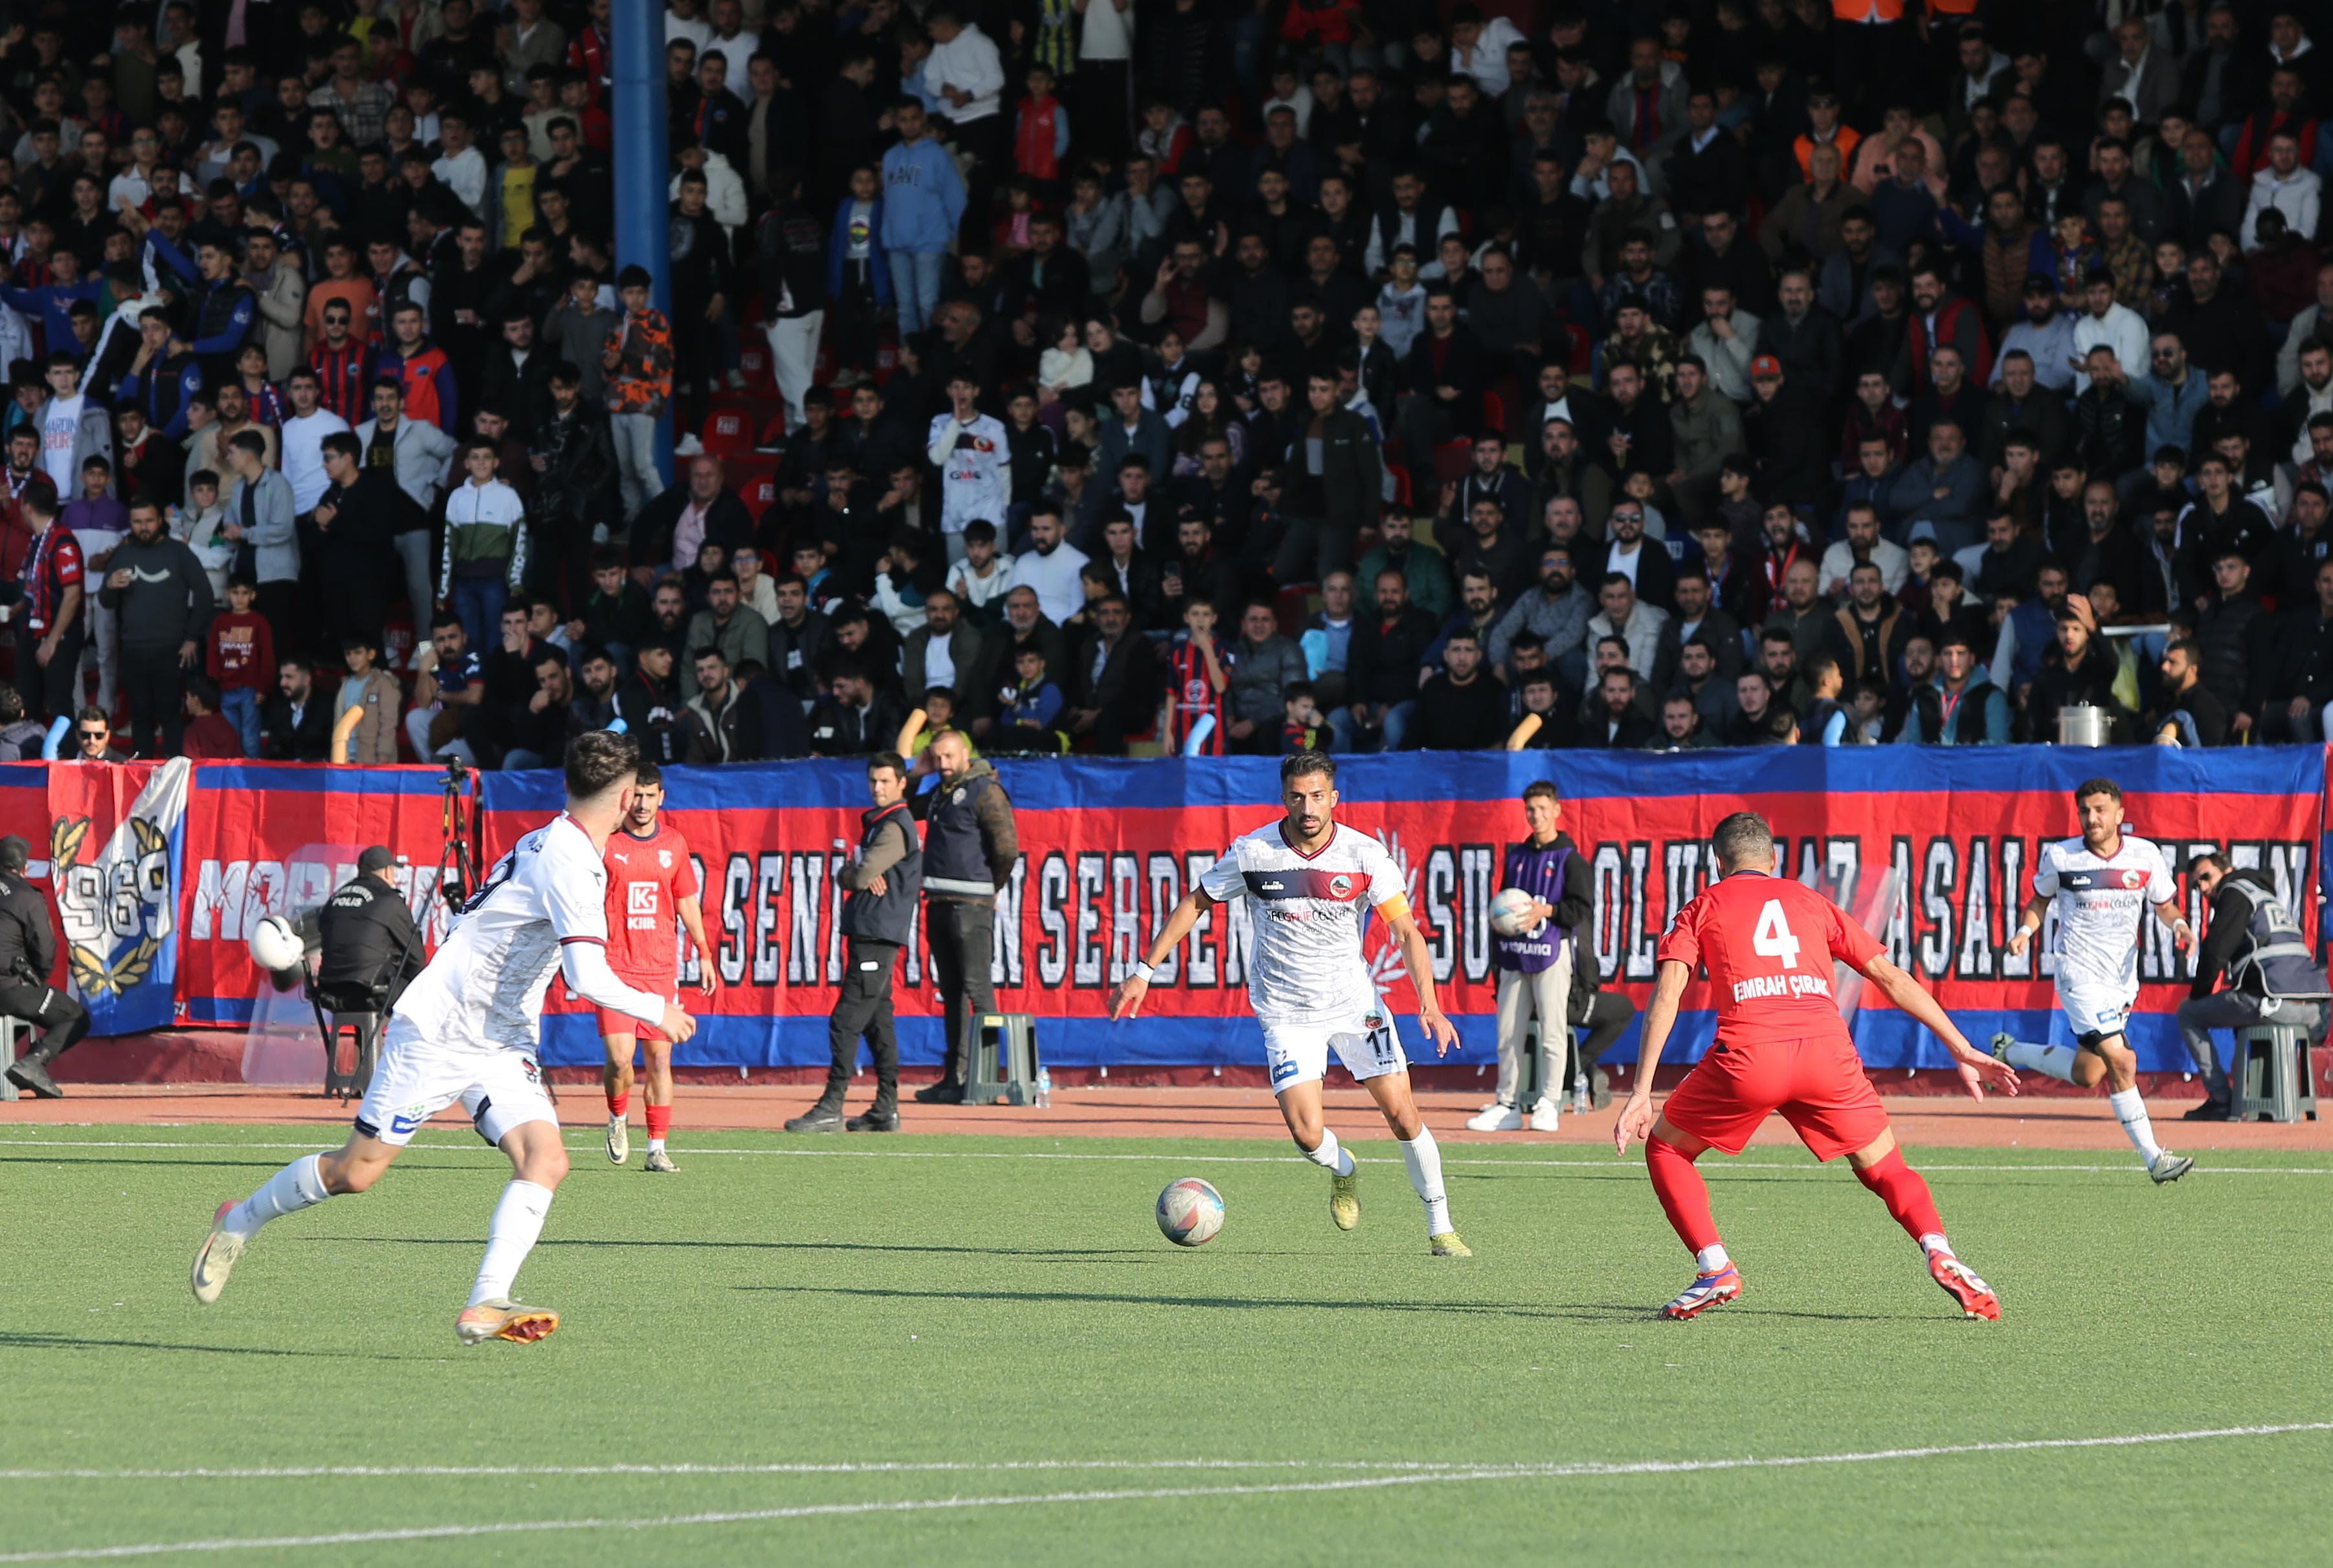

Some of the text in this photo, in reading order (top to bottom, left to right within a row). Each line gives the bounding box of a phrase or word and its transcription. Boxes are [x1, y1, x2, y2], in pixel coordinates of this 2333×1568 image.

[1752, 899, 1800, 969] 4
[1733, 974, 1788, 1003] EMRAH
[1367, 1027, 1391, 1058] 17
